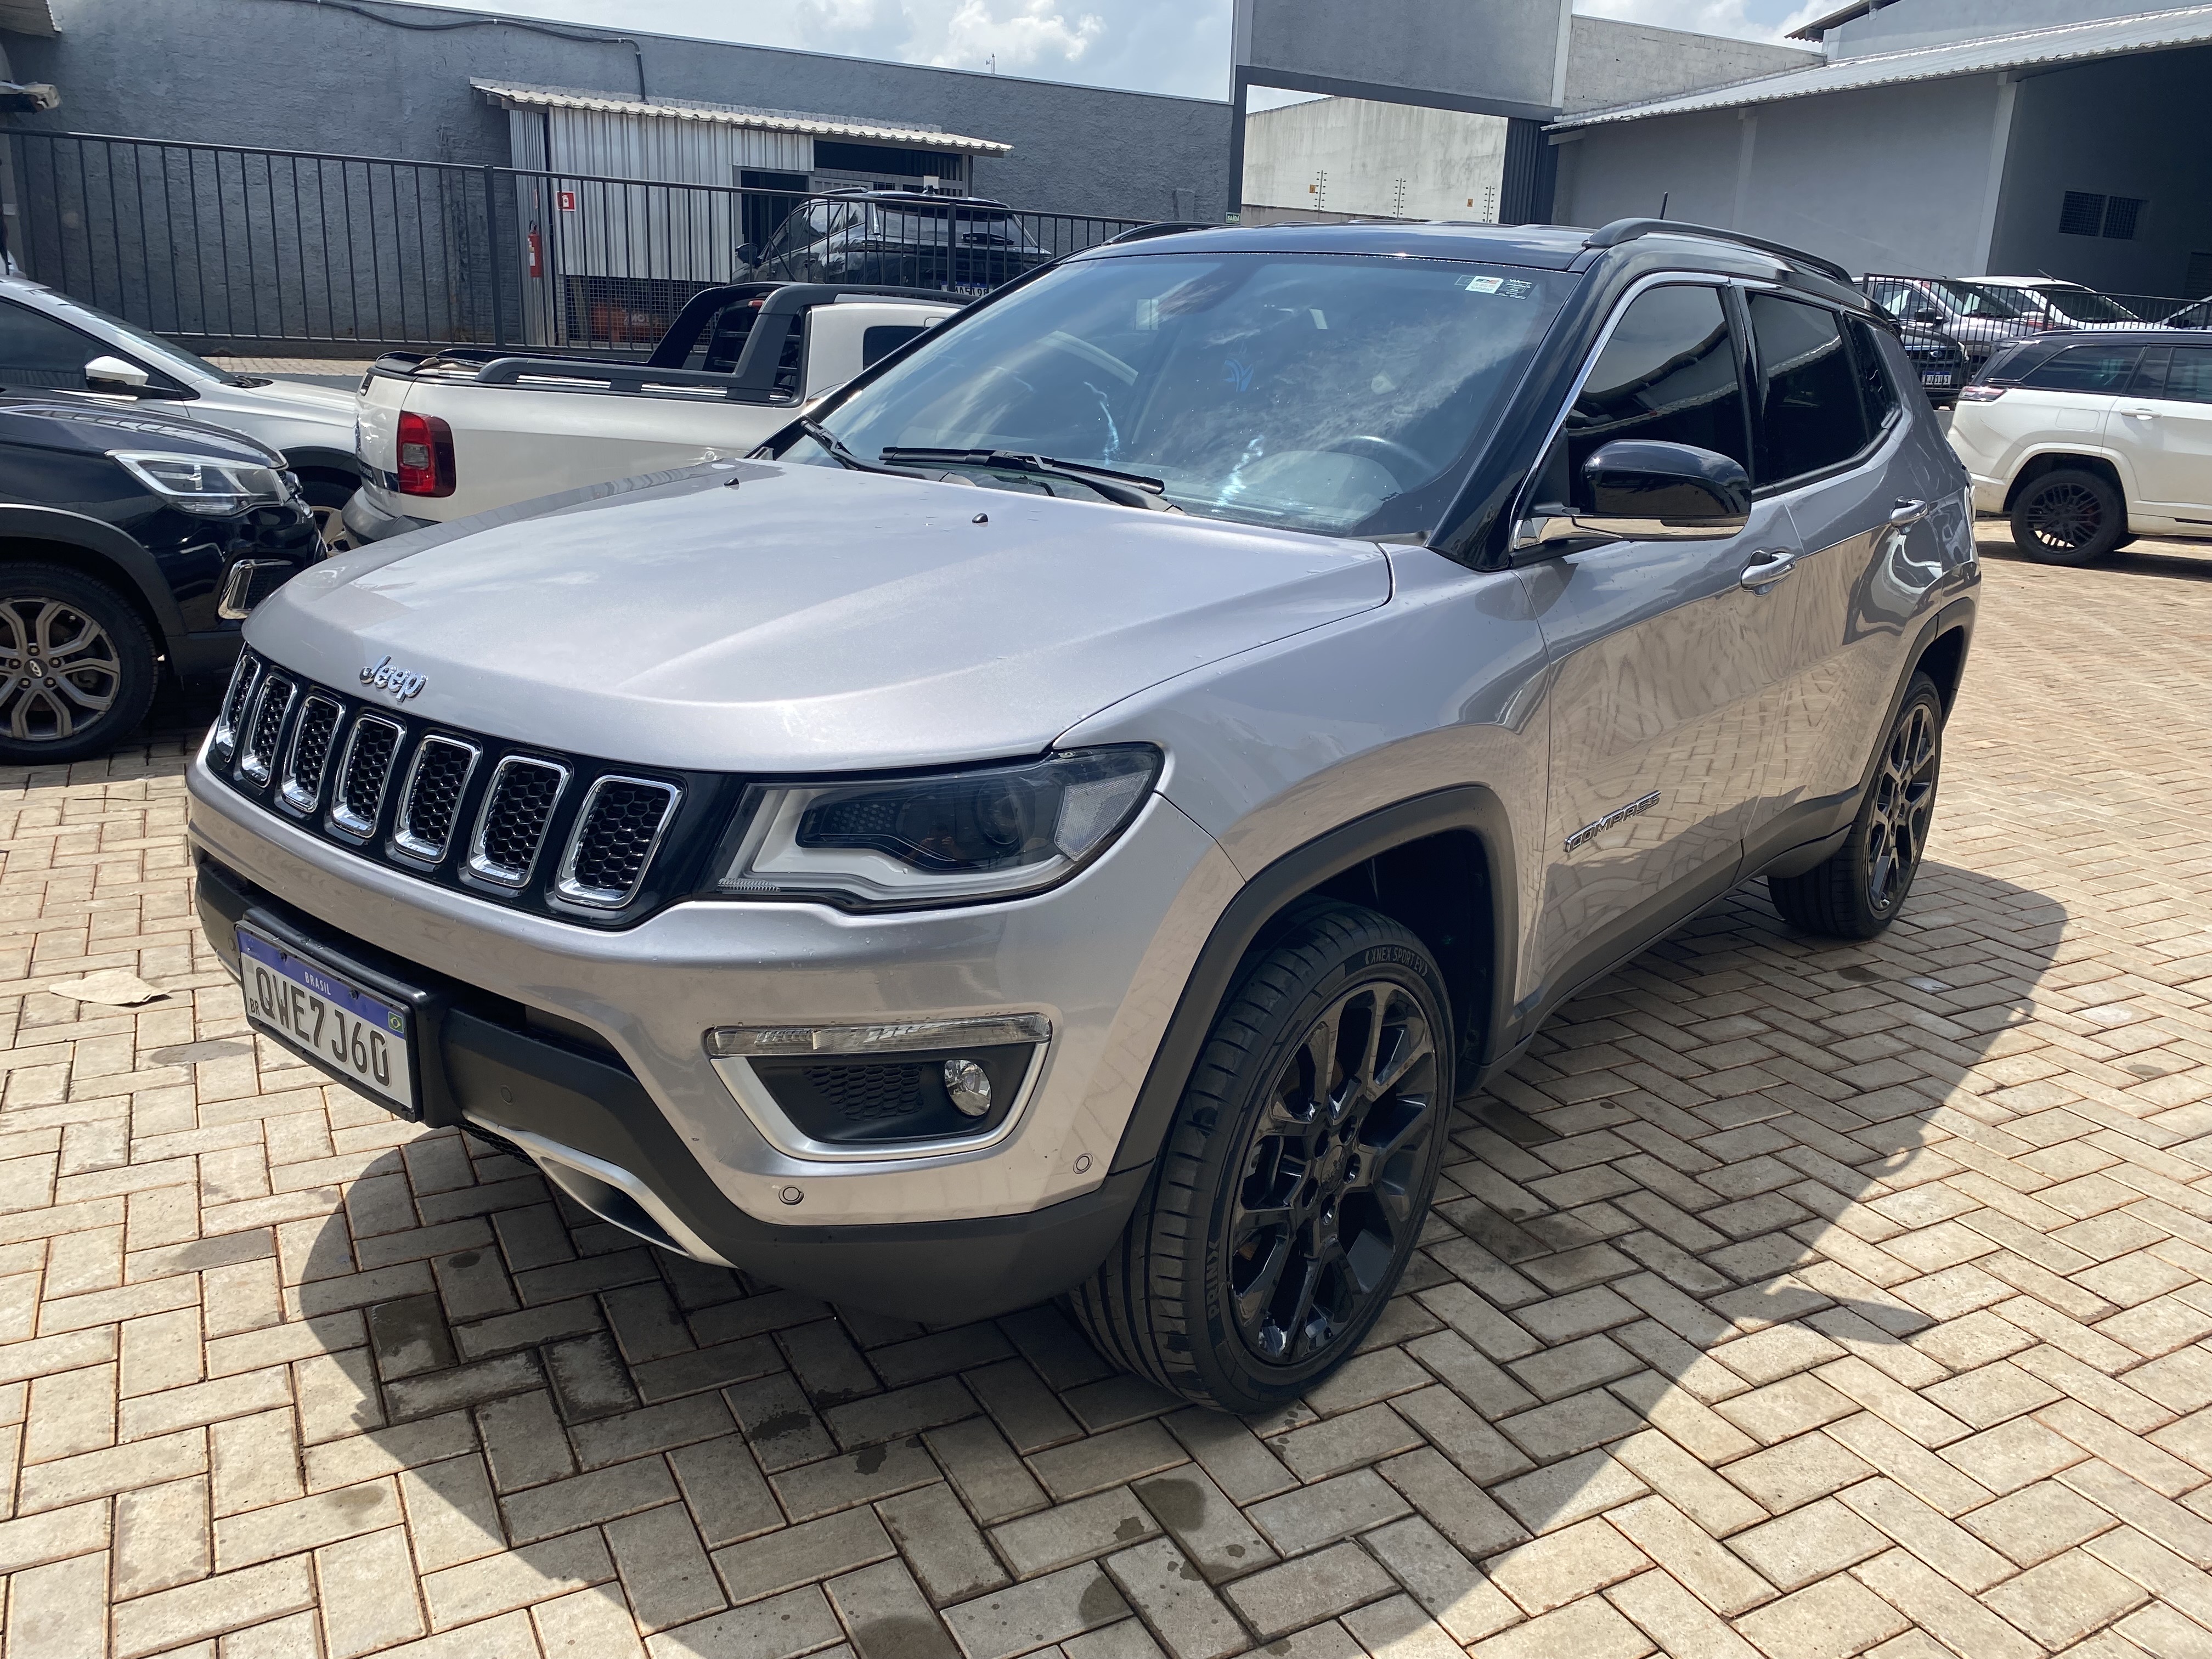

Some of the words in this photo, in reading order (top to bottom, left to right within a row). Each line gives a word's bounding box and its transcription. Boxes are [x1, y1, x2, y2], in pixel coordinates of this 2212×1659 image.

[359, 655, 427, 702] Jeep
[1563, 789, 1661, 853] COMPASS
[304, 971, 331, 996] BRASIL
[1370, 947, 1391, 964] XNEX
[1392, 947, 1415, 966] SPORT
[1414, 956, 1424, 973] EV
[249, 997, 261, 1016] BR
[256, 967, 390, 1087] QWE7J60
[1206, 1238, 1221, 1321] PRINX
